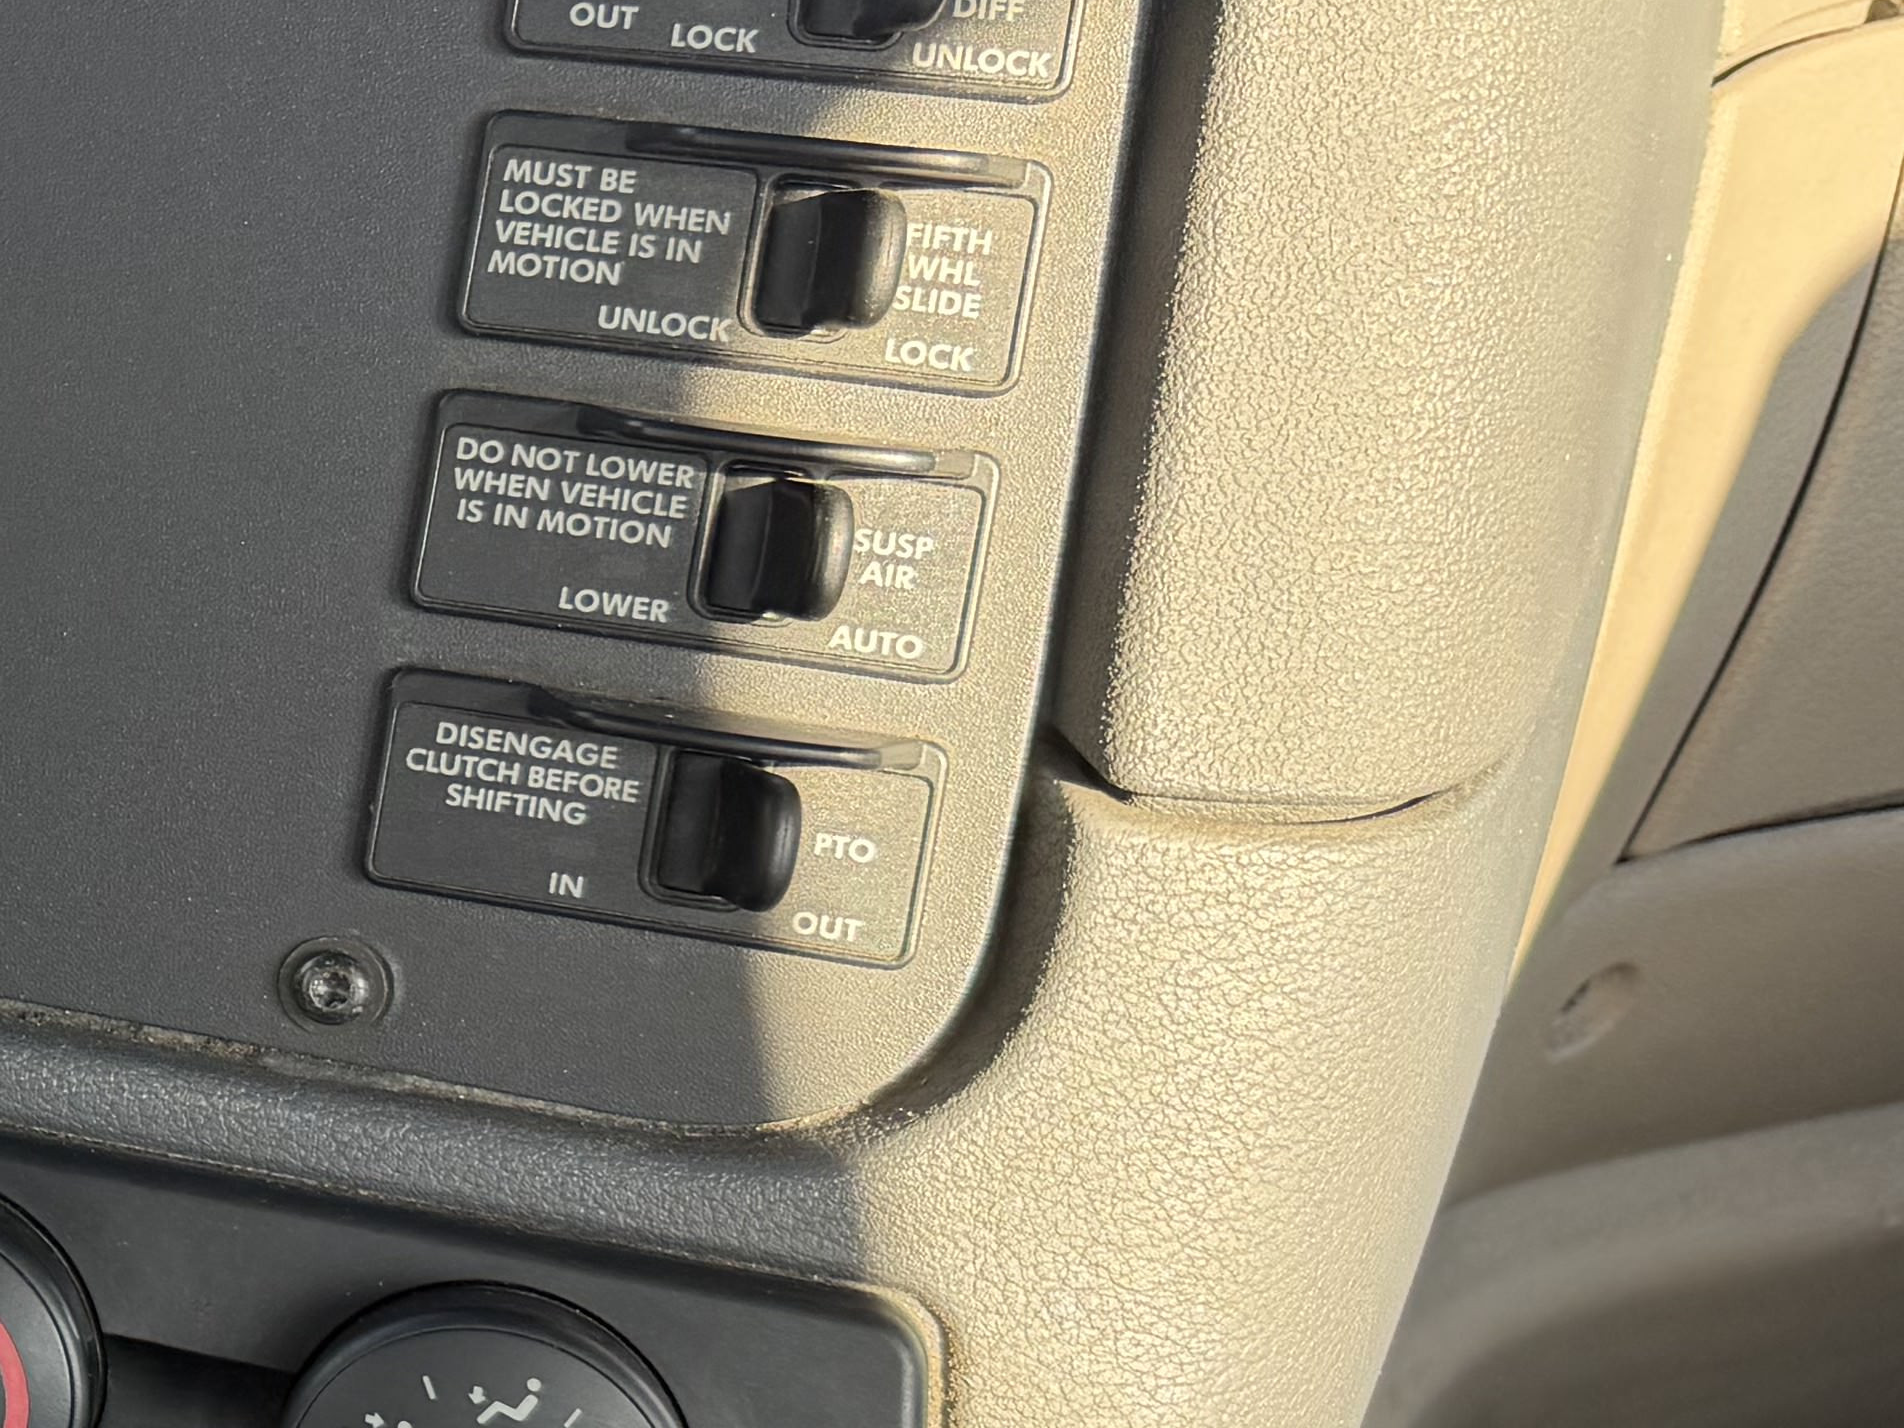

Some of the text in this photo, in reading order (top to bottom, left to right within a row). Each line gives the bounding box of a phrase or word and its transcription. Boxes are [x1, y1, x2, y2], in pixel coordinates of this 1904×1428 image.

[569, 2, 640, 30] OUT
[670, 22, 760, 54] LOCK
[912, 42, 1051, 78] UNLOCK
[503, 158, 637, 194] MUST BE
[498, 189, 732, 236] LOCKED WHEN
[494, 218, 703, 264] VEHICLE IS IN
[904, 222, 992, 256] FIFTH
[487, 249, 622, 286] MOTION
[905, 253, 982, 287] WHL
[892, 285, 982, 320] SLIDE
[598, 304, 733, 344] UNLOCK
[884, 337, 975, 372] LOCK
[457, 436, 694, 490] DO NOT LOWER
[453, 466, 688, 520] WHEN VEHICLE
[457, 498, 673, 549] IS IN MOTION
[853, 527, 935, 560] SUSP
[859, 559, 918, 591] AIR
[558, 585, 670, 624] LOWER
[828, 624, 924, 660] AUTO
[435, 721, 619, 771] DISENGAGE
[406, 747, 641, 804] CLUTCH BEFORE
[445, 783, 588, 826] SHIFTING
[813, 832, 877, 864] PTO
[548, 871, 585, 898] IN
[792, 911, 864, 943] OUT
